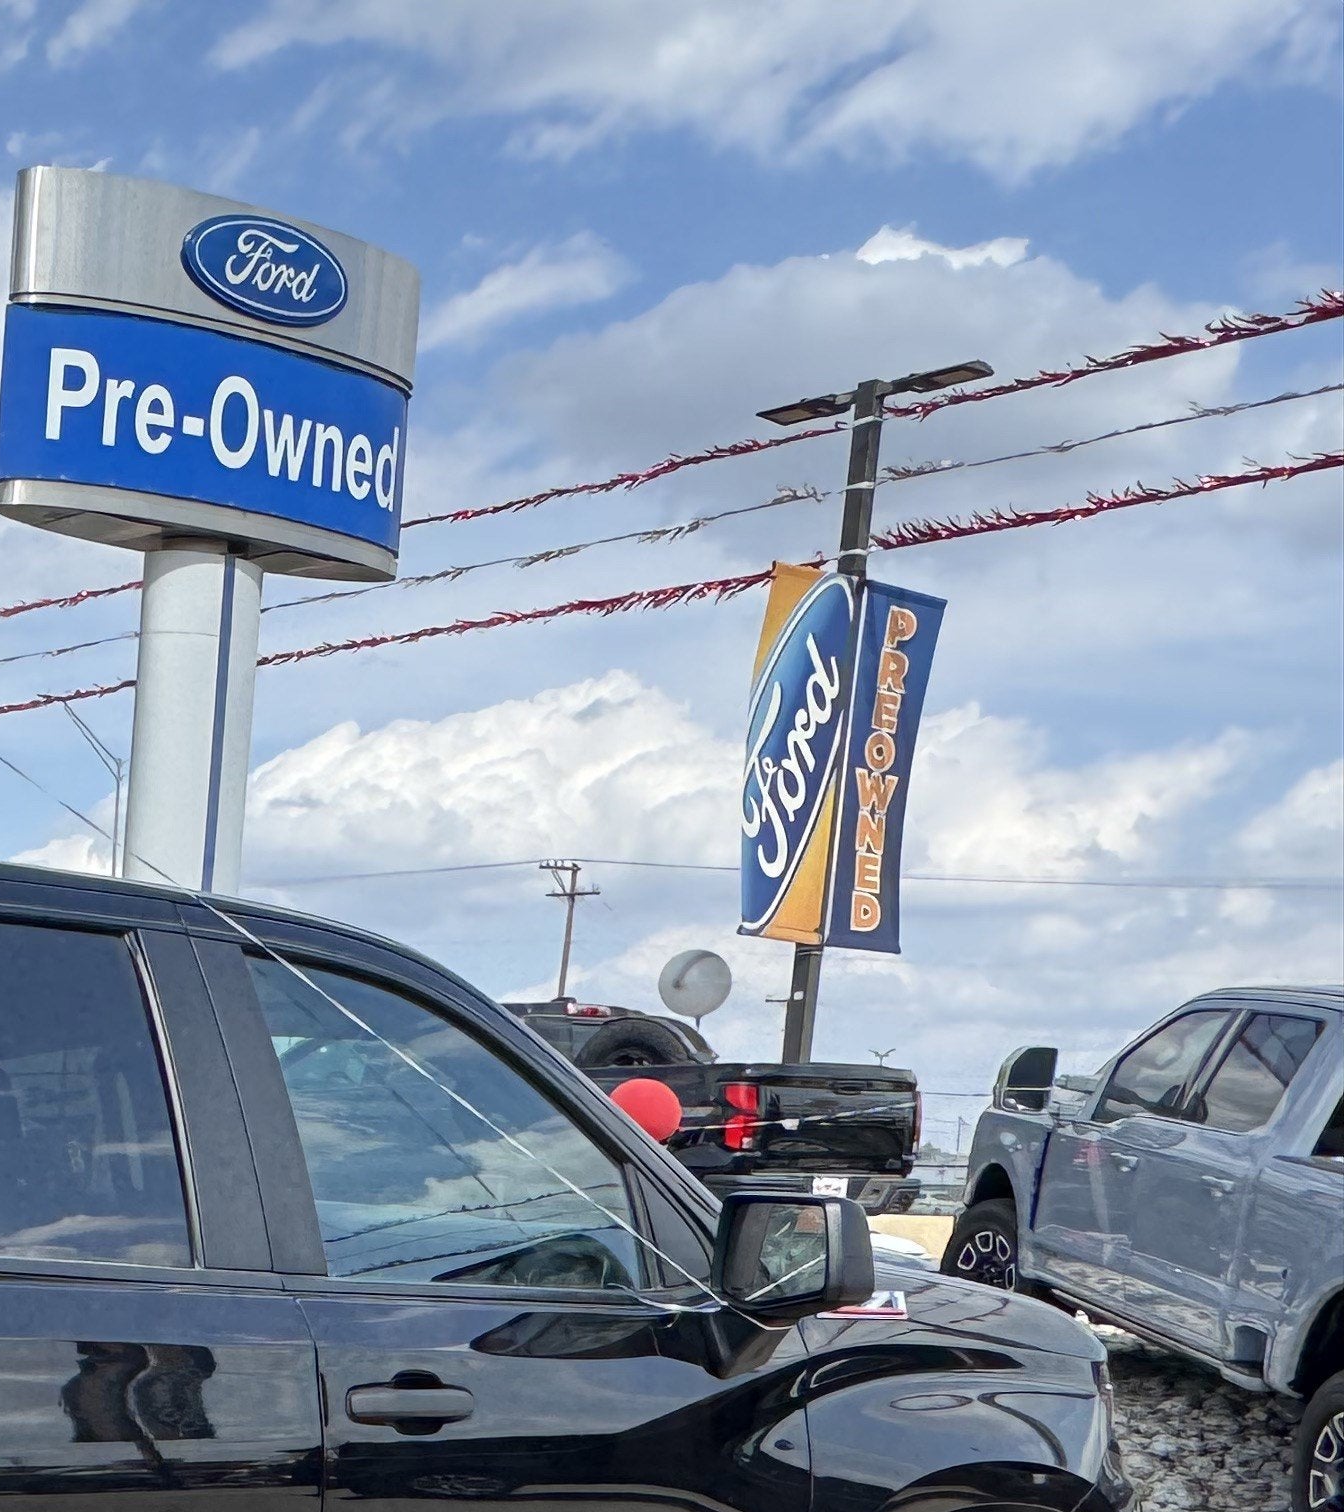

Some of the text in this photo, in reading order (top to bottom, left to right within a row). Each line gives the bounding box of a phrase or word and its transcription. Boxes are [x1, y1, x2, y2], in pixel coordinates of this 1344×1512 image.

[224, 228, 320, 303] Ford
[44, 347, 400, 512] Pre-Owned
[742, 632, 841, 879] Ford
[850, 605, 918, 932] PREOWNED
